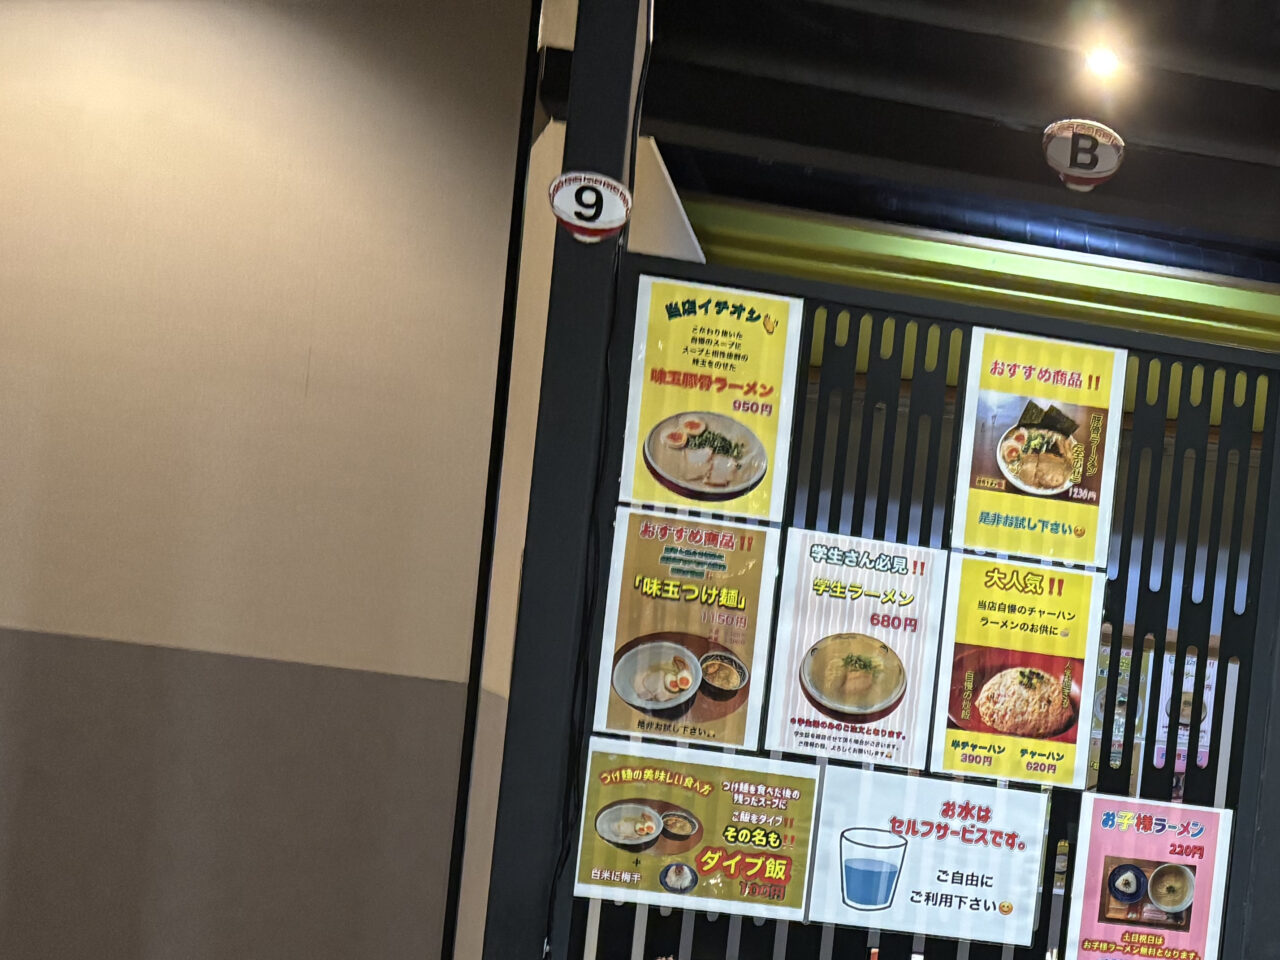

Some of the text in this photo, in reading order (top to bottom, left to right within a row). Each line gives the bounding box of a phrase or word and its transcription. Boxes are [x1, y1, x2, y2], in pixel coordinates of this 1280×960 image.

[1069, 132, 1099, 170] B
[574, 185, 603, 222] 9
[665, 299, 762, 323] 当店イチオシ
[650, 367, 774, 398] 味玉豚骨ラーメン
[733, 400, 772, 416] 950円
[978, 511, 1072, 535] 是非お試し下さい
[634, 574, 746, 610] 「味玉つけ麺」
[813, 577, 915, 607] 学生ラーメン
[978, 600, 1076, 621] 当店自慢のチャーハン
[870, 613, 918, 633] 680円
[980, 617, 1058, 636] ラーメンのお供に
[951, 740, 1005, 754] 半チャーハン
[1020, 748, 1064, 761] チャーハン
[960, 754, 992, 766] 390円
[1026, 762, 1057, 774] 620円
[941, 800, 993, 823] お水は
[889, 815, 1027, 851] セルフサービスです。
[1101, 810, 1206, 839] お子様ラーメン
[700, 850, 788, 881] ダイブ飯
[936, 869, 994, 888] ご自由に
[910, 891, 997, 912] ご利用下さい
[1122, 931, 1164, 945] 土日祝日は
